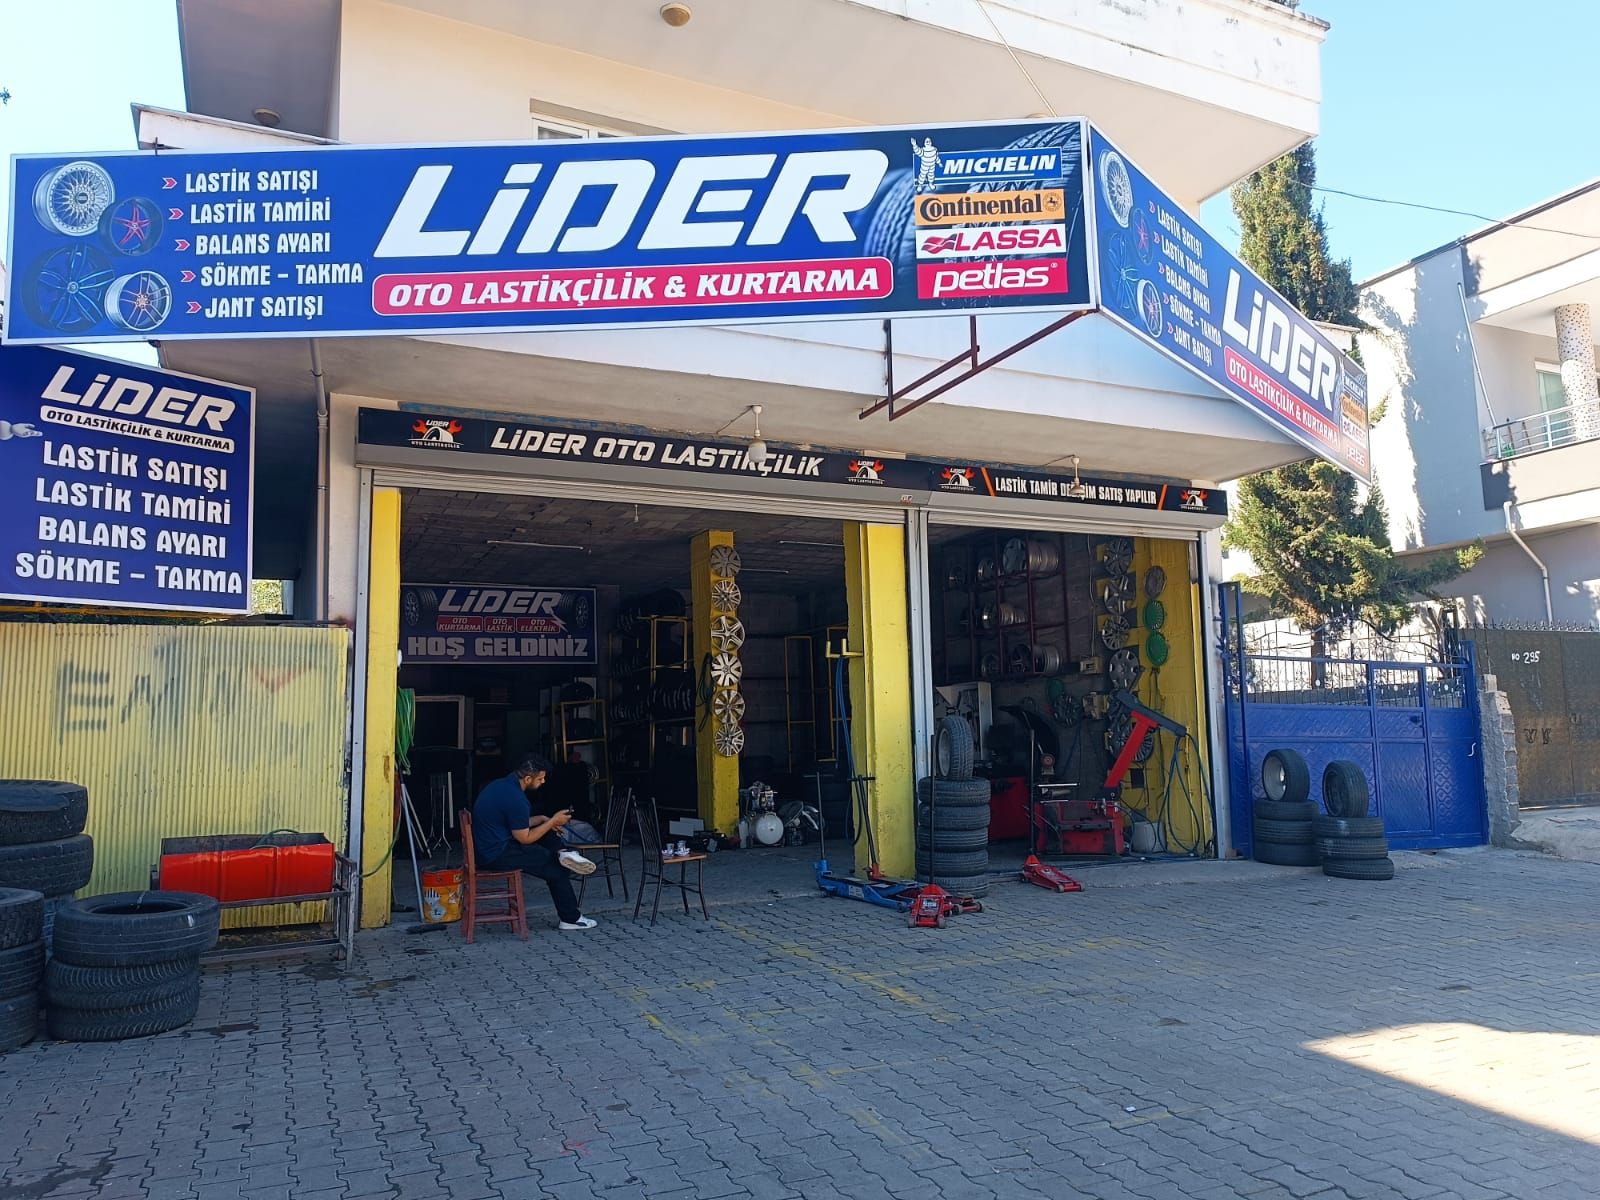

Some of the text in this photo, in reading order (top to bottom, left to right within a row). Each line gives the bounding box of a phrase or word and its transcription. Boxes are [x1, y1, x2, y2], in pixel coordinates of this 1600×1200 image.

[185, 168, 319, 195] LASTİK SATIŞI
[943, 154, 1057, 175] MICHELIN
[190, 197, 331, 224] LASTİK TAMİRİ
[920, 193, 1042, 222] Continental
[195, 232, 331, 256] BALANS AYARI
[955, 228, 1062, 252] LASSA
[1157, 204, 1203, 260] LASTİK SATIŞI
[200, 262, 271, 287] SÖKME
[295, 263, 363, 286] TAKMA
[1161, 234, 1209, 289] LASTİK TAMİRİ
[388, 267, 880, 308] OTO LASTİKÇİLİK & KURTARMA
[933, 262, 1049, 298] petlas
[1165, 264, 1192, 300] BALANS
[205, 295, 323, 321] JANT SATIŞI
[1174, 325, 1213, 368] JANT SATIŞI
[1229, 357, 1247, 383] OTO
[1248, 370, 1295, 417] LASTİKÇİLİK
[1302, 409, 1339, 447] KURTARMA
[46, 409, 231, 451] OTO LASTİKÇİLİK & KURTARMA
[43, 440, 227, 493] LASTİK SATIŞI
[593, 437, 656, 463] OTO
[660, 443, 825, 478] LASTİKÇİLİK
[35, 477, 232, 526] LASTİK TAMİRİ
[995, 476, 1027, 494] LASTİK
[1030, 479, 1058, 496] TAMİR
[1098, 486, 1124, 504] SATIŞ
[1125, 487, 1157, 505] YAPILIR
[38, 515, 226, 559] BALANS AYARI
[15, 549, 121, 585] SÖKME
[154, 565, 243, 595] TAKMA
[452, 617, 468, 625] OTO
[407, 634, 588, 660] HOŞ GELDİNİZ
